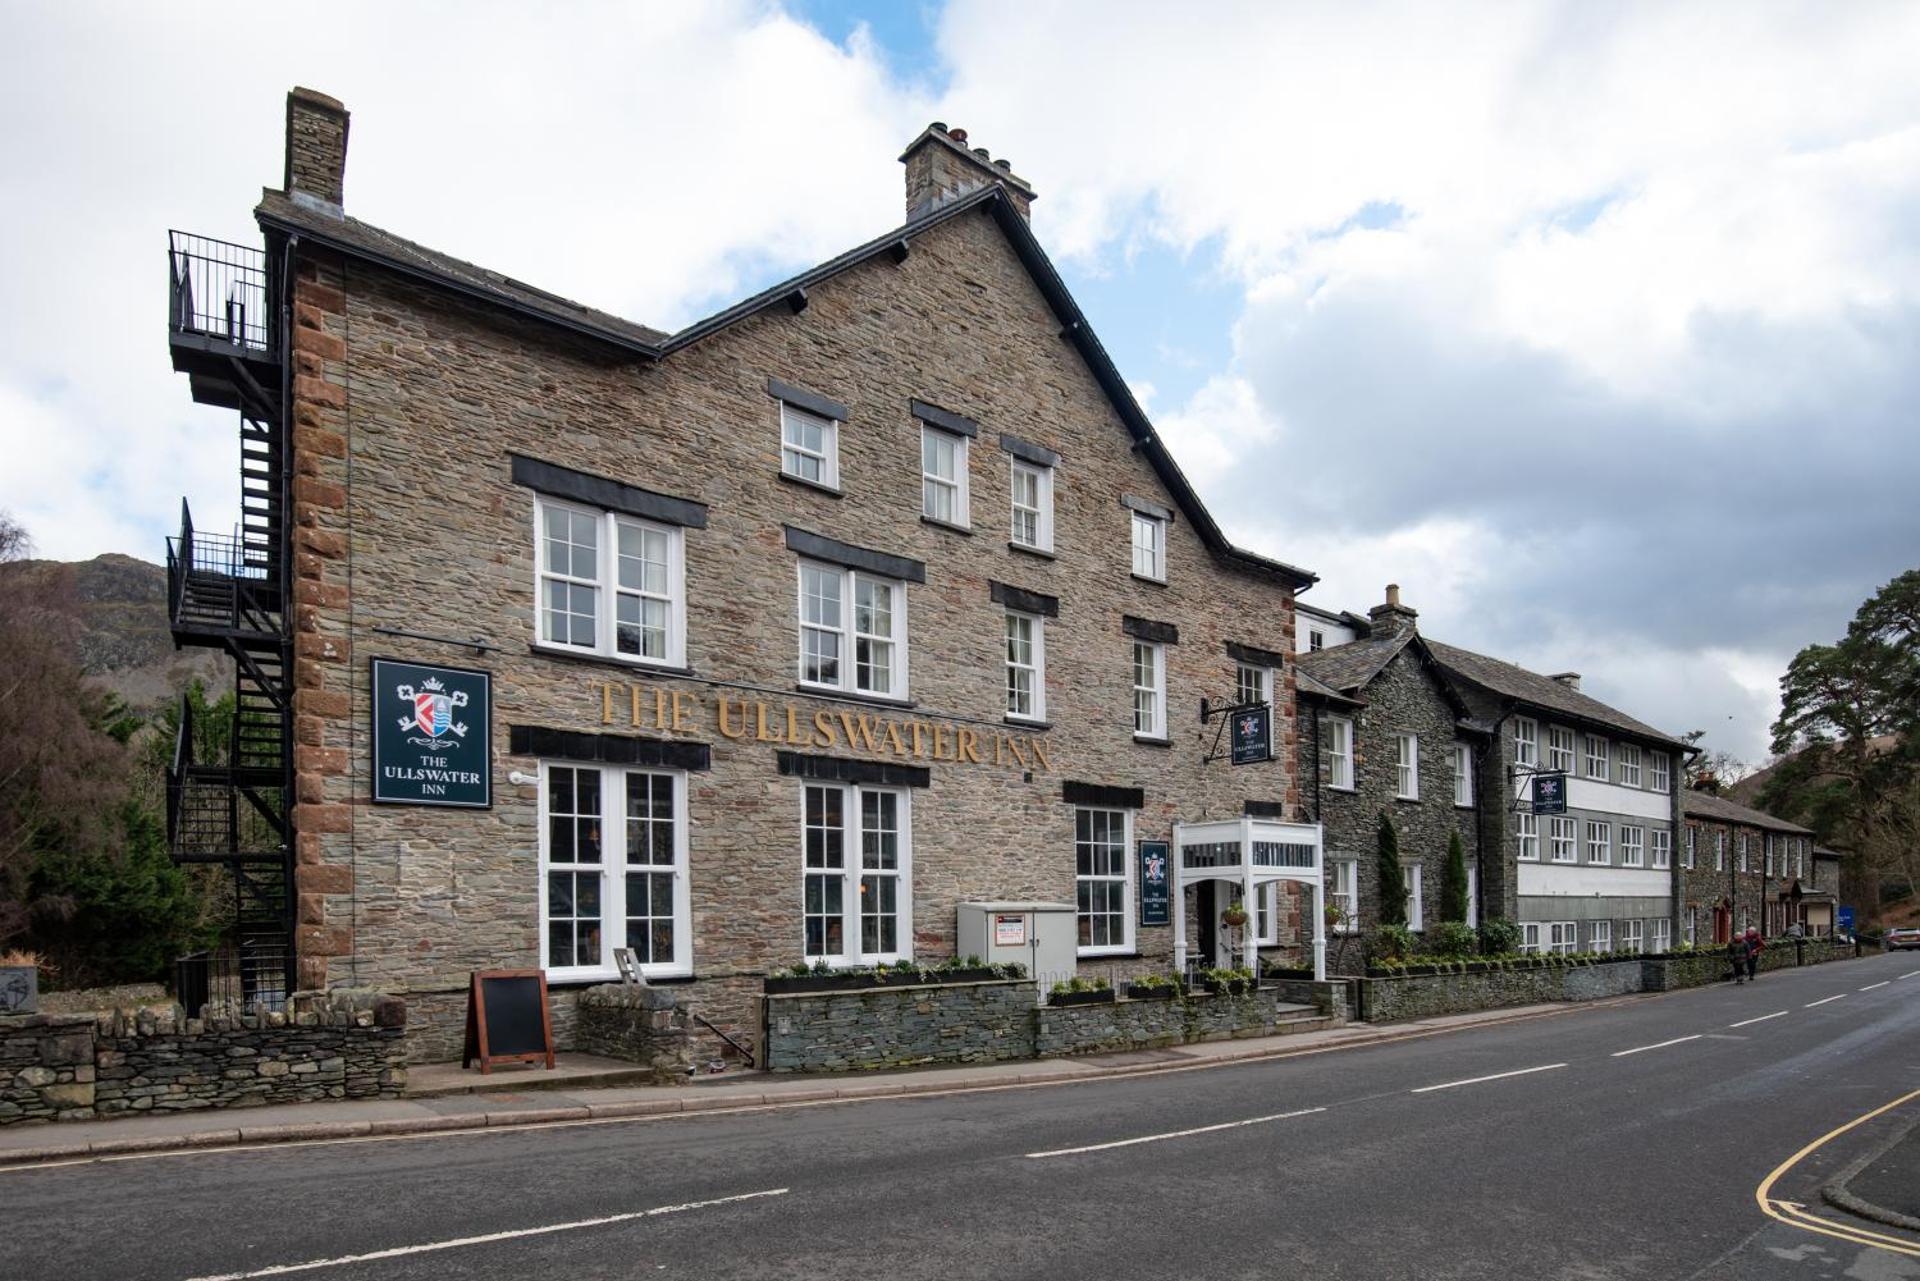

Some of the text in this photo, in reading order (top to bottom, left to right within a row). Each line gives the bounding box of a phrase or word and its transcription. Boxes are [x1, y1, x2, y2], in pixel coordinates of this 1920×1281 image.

[588, 678, 1055, 771] THE ULLSWATER INN
[420, 755, 448, 768] THE
[384, 766, 480, 784] ULLSWATER
[422, 783, 446, 795] INN
